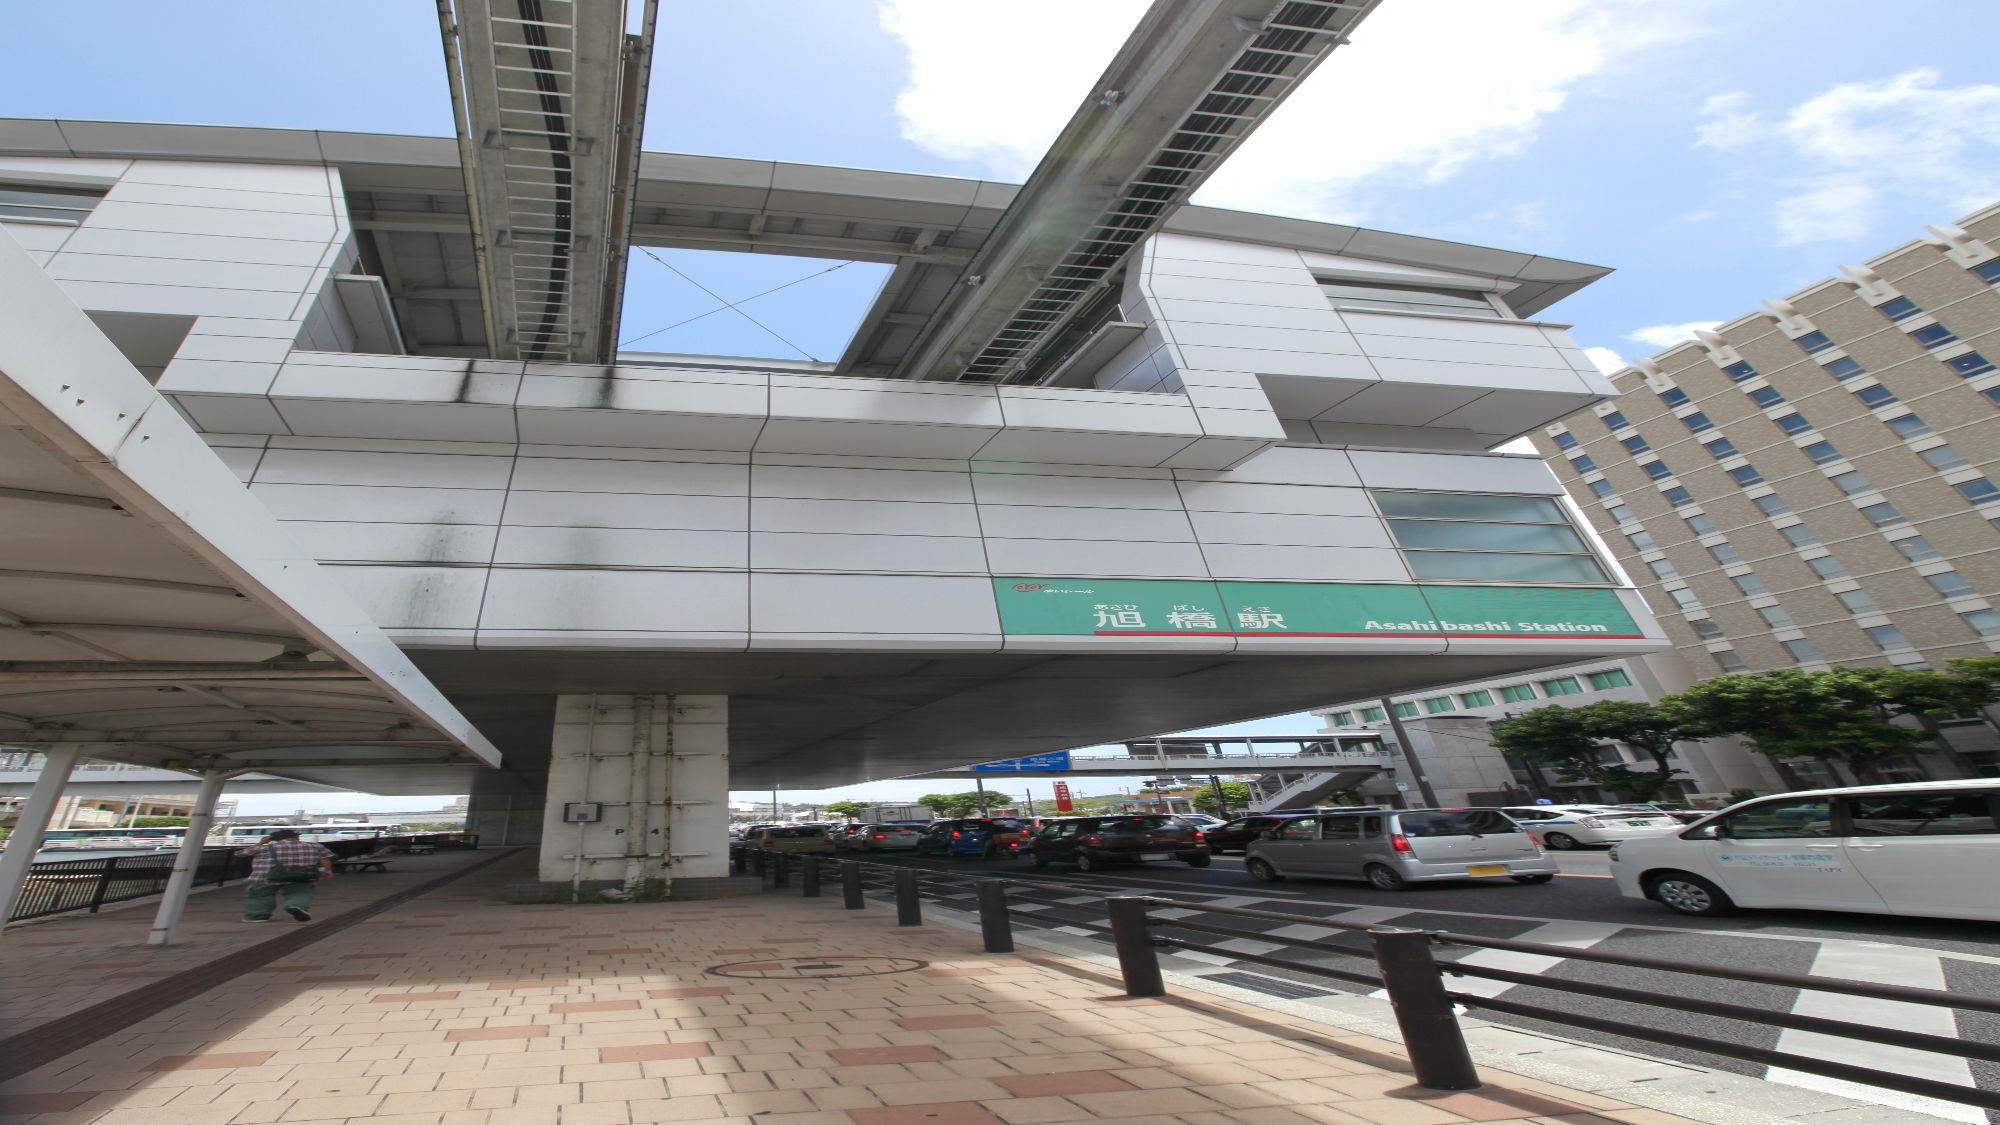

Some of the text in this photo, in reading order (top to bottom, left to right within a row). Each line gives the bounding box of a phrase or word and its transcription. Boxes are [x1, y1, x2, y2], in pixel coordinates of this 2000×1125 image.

[1093, 611, 1288, 629] 旭橋駅
[1364, 620, 1608, 632] Asahibashi Station
[615, 828, 625, 836] P
